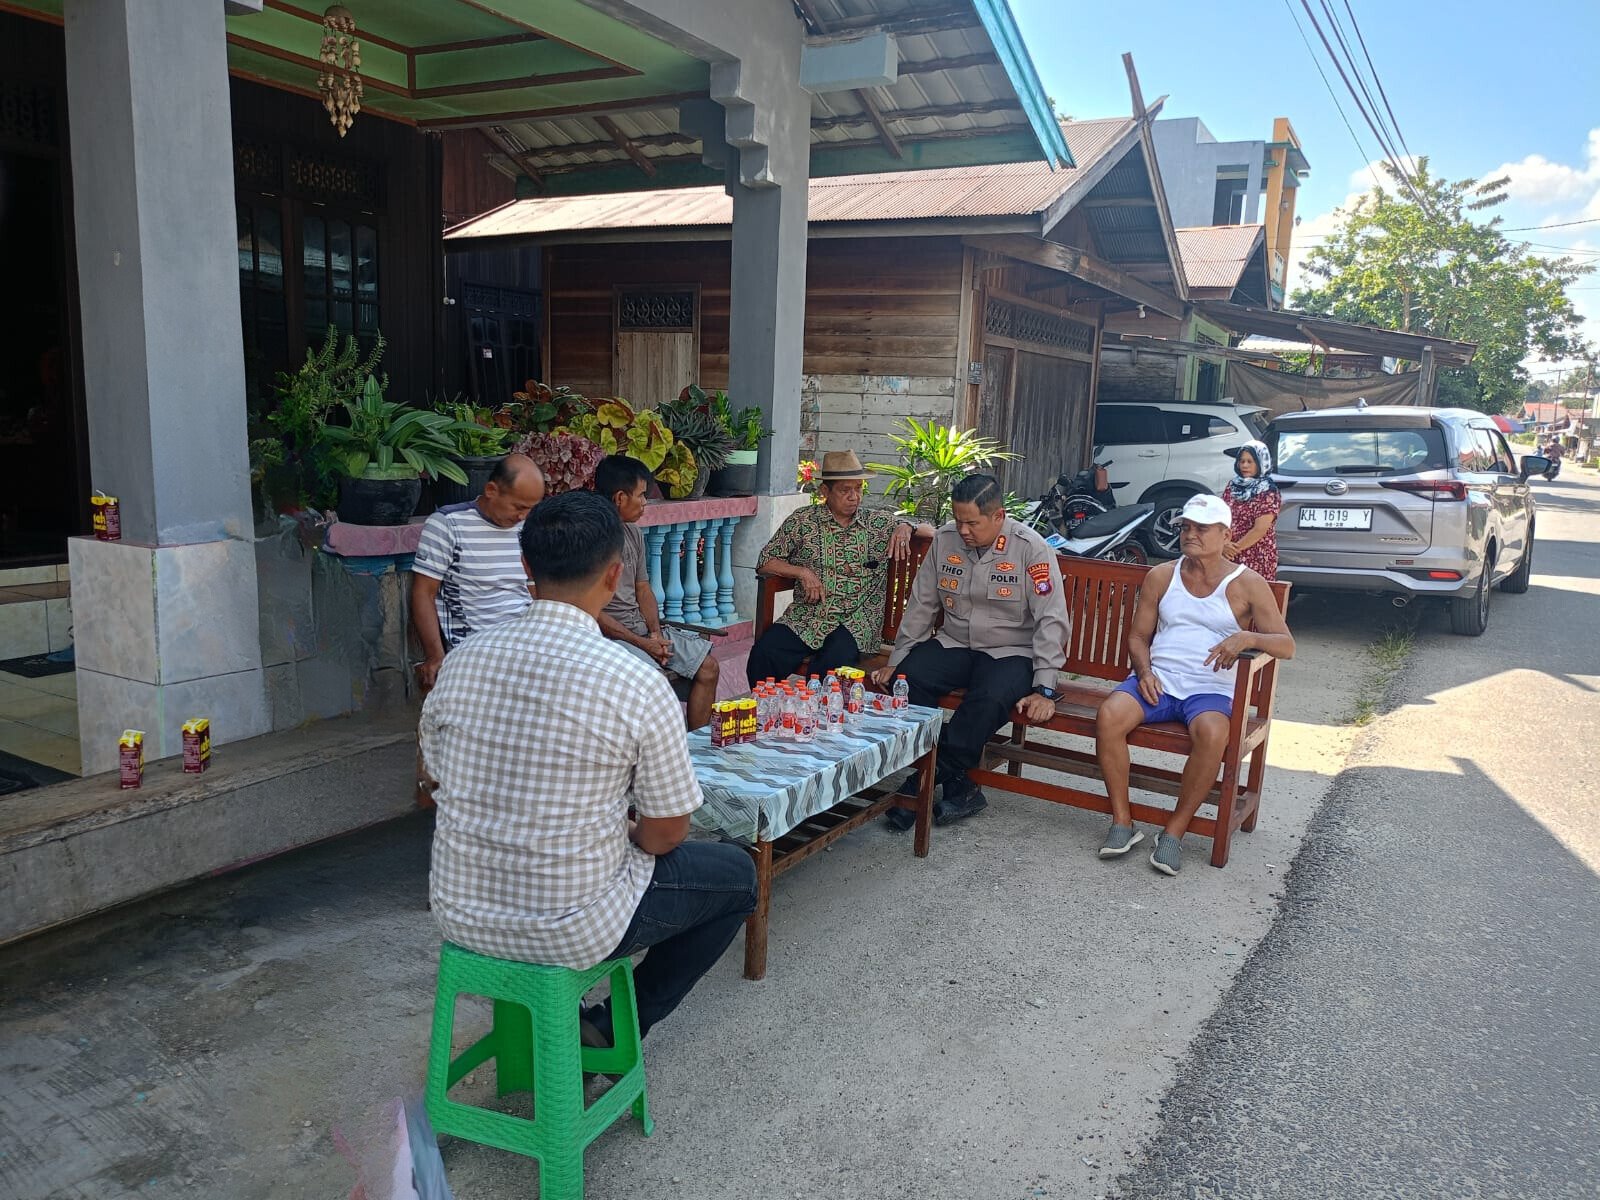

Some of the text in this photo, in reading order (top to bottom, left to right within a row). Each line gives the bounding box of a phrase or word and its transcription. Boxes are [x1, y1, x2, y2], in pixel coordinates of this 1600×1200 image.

[1301, 509, 1371, 522] KH 1619 Y
[941, 564, 963, 576] THEO
[990, 574, 1018, 583] POLRI
